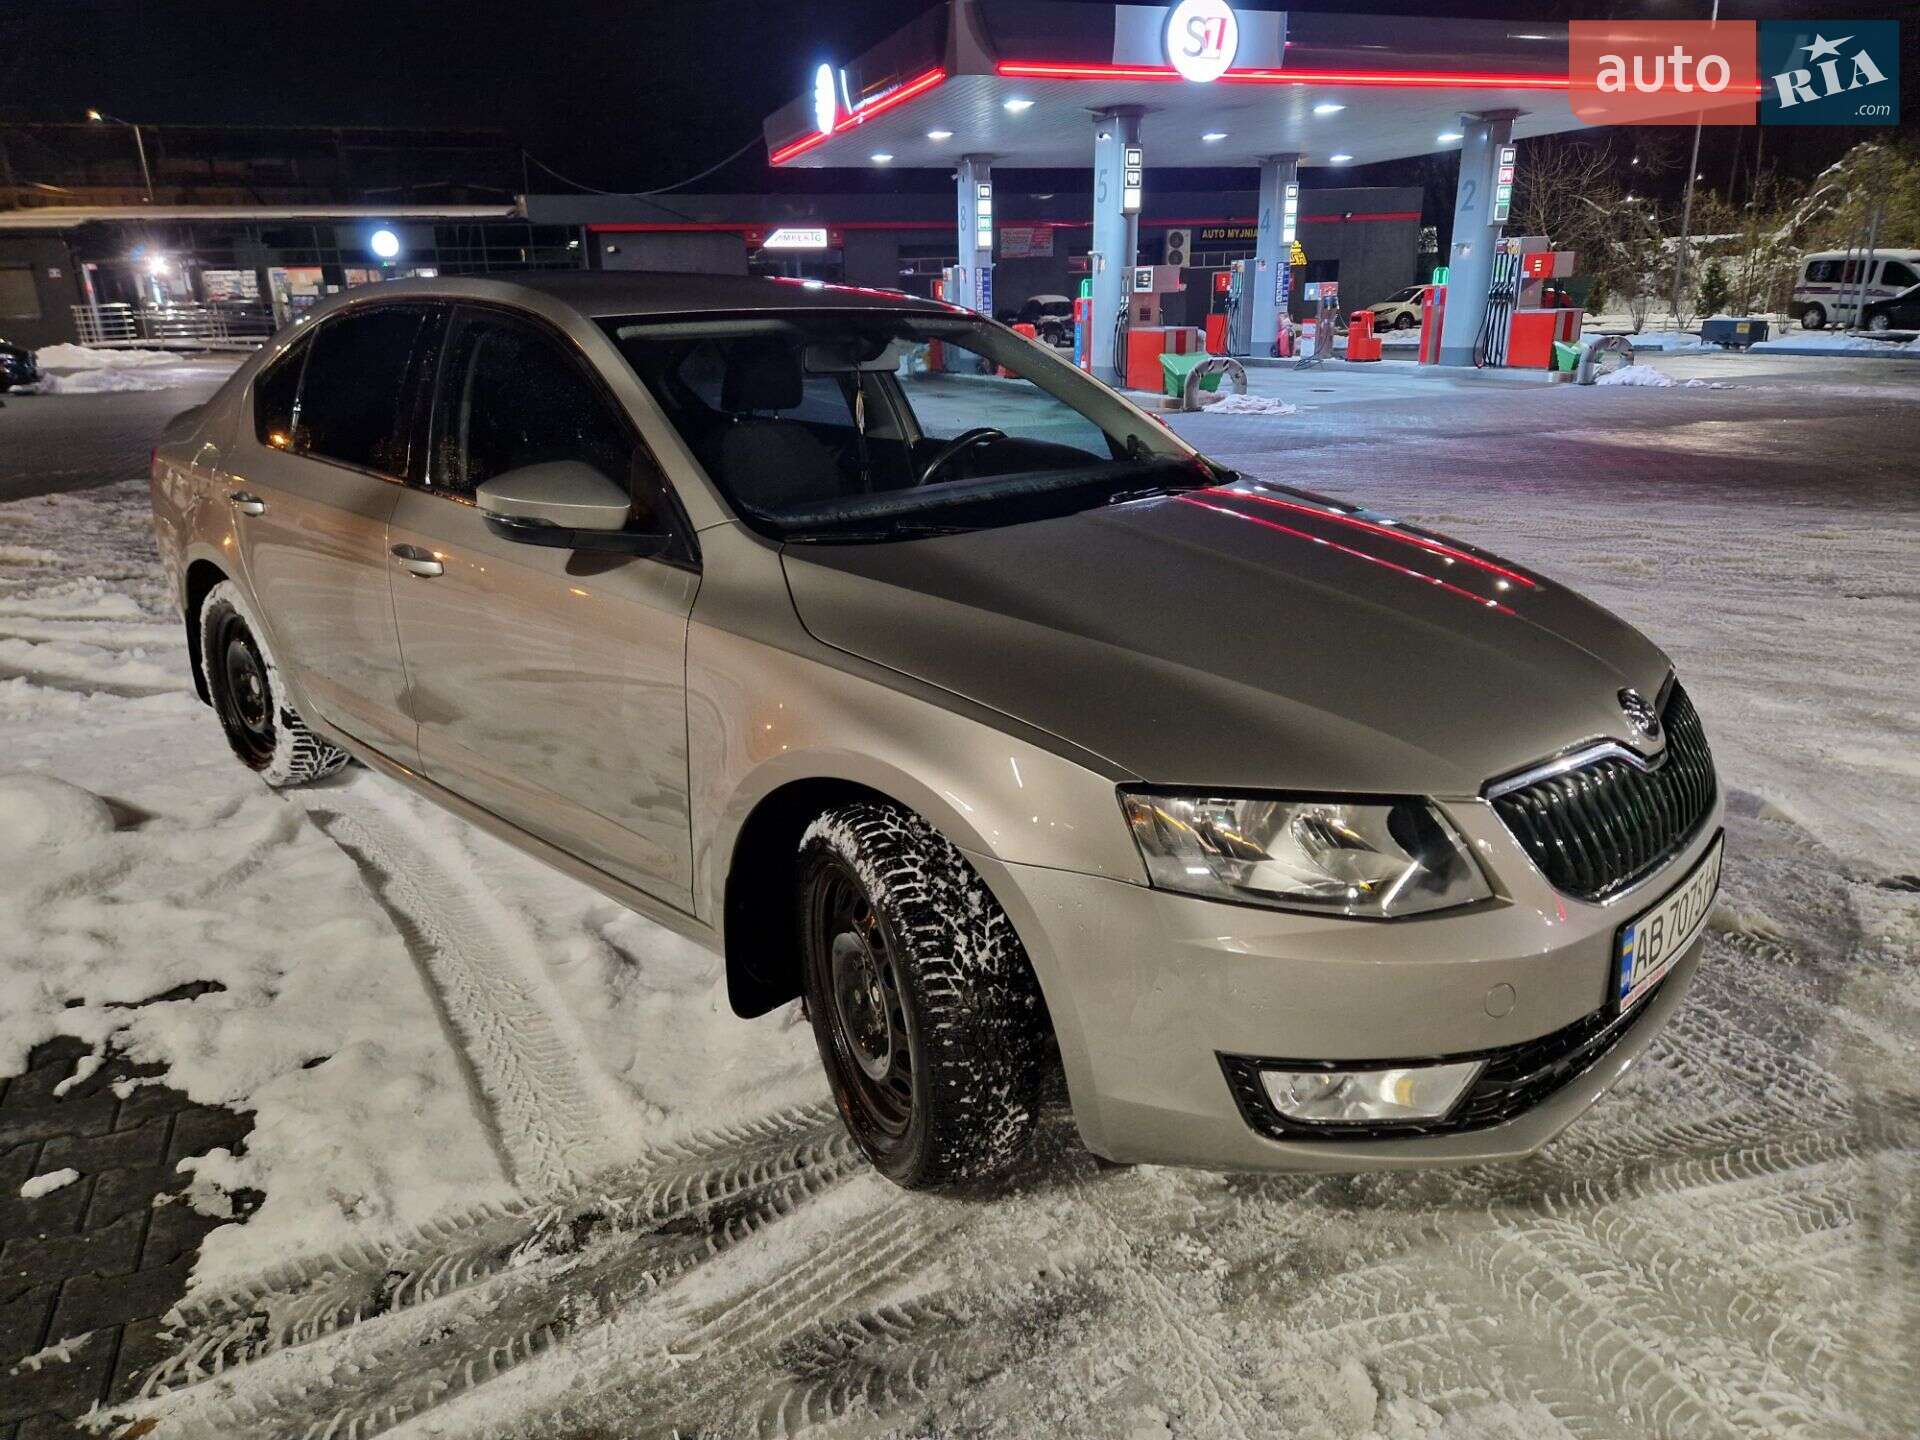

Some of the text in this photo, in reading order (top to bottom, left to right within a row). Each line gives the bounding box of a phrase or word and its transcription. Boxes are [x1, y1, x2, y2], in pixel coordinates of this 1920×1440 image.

[1097, 169, 1107, 203] 5
[1461, 179, 1476, 212] 2
[1202, 228, 1258, 239] AUTO MYJNIA
[1261, 208, 1271, 233] 4
[1633, 913, 1664, 979] AB
